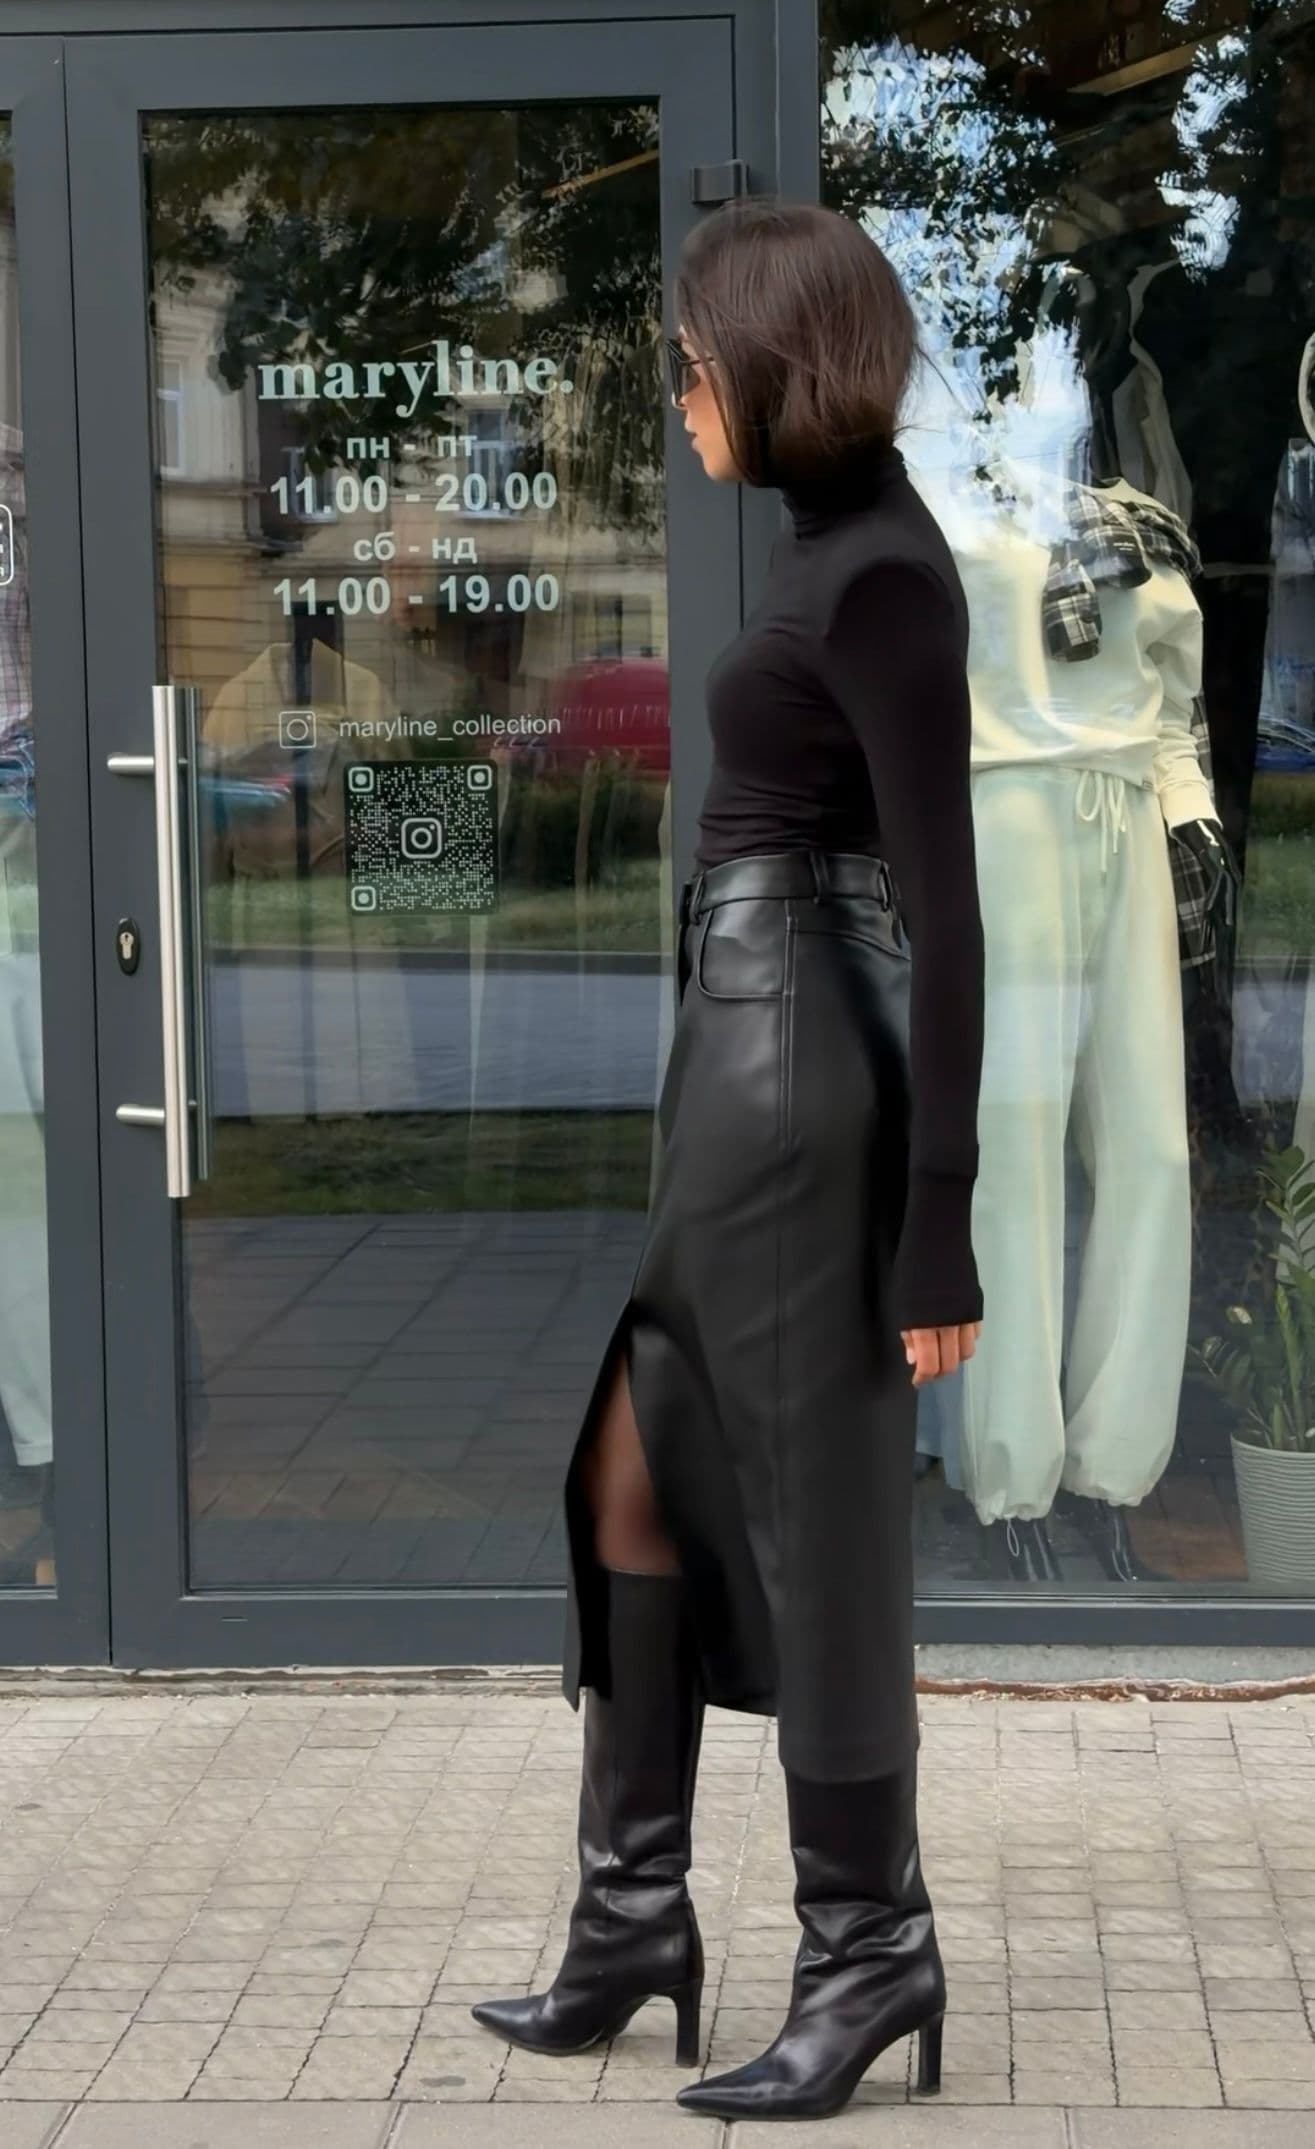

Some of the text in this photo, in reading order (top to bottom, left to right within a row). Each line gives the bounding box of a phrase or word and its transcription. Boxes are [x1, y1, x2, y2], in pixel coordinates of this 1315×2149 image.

[258, 340, 574, 418] maryline.
[347, 437, 390, 459] пн
[437, 435, 478, 457] пт
[270, 472, 558, 514] 11.00 - 20.00
[353, 531, 477, 563] сб - нд
[273, 574, 559, 615] 11.00 - 19.00
[339, 714, 561, 742] maryline_collection
